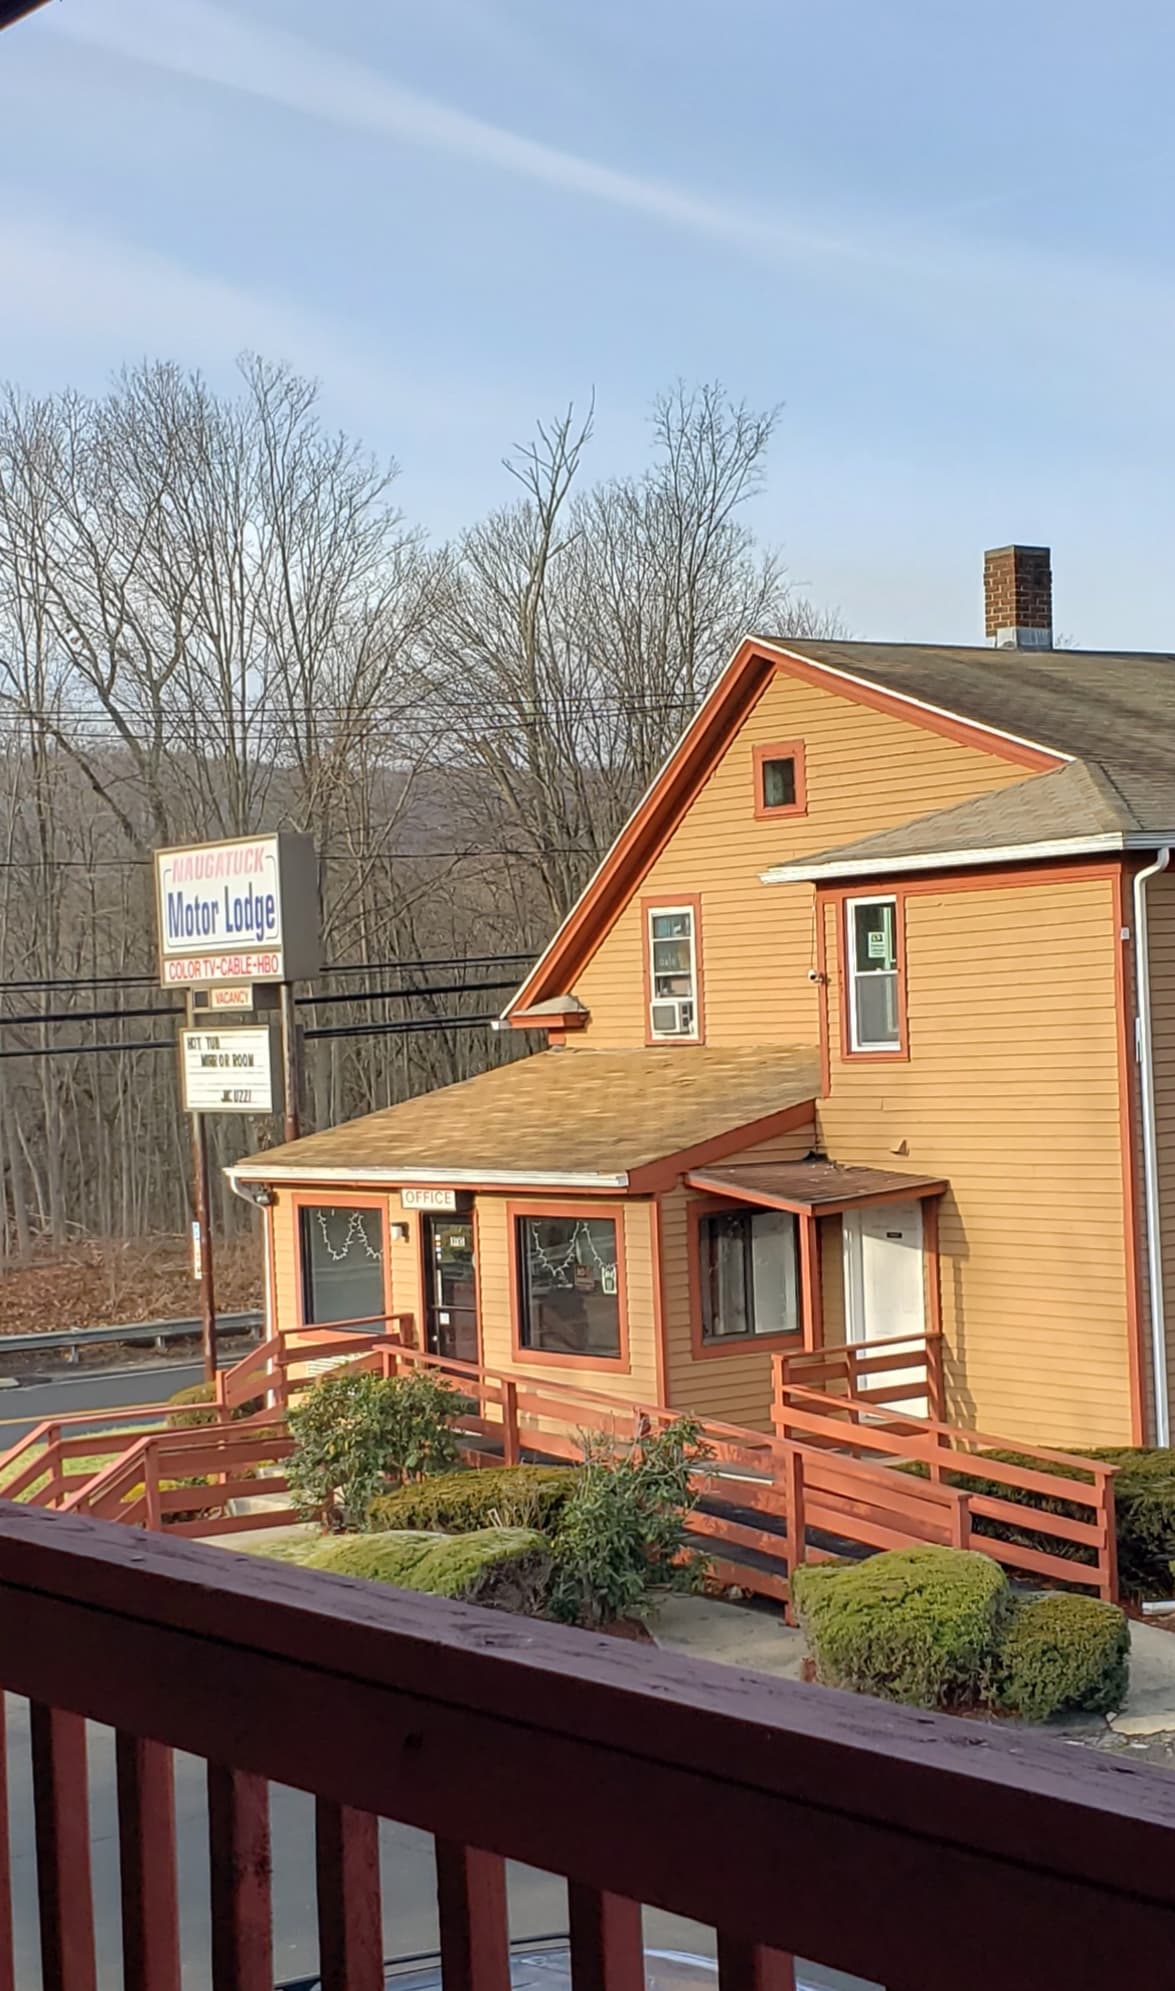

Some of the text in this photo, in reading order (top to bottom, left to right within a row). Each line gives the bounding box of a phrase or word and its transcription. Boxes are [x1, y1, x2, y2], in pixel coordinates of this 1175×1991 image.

[172, 847, 265, 883] NAUGATUCK
[167, 881, 275, 942] Motor Lodge
[169, 960, 202, 981] COLOR
[405, 1190, 452, 1205] OFFICE
